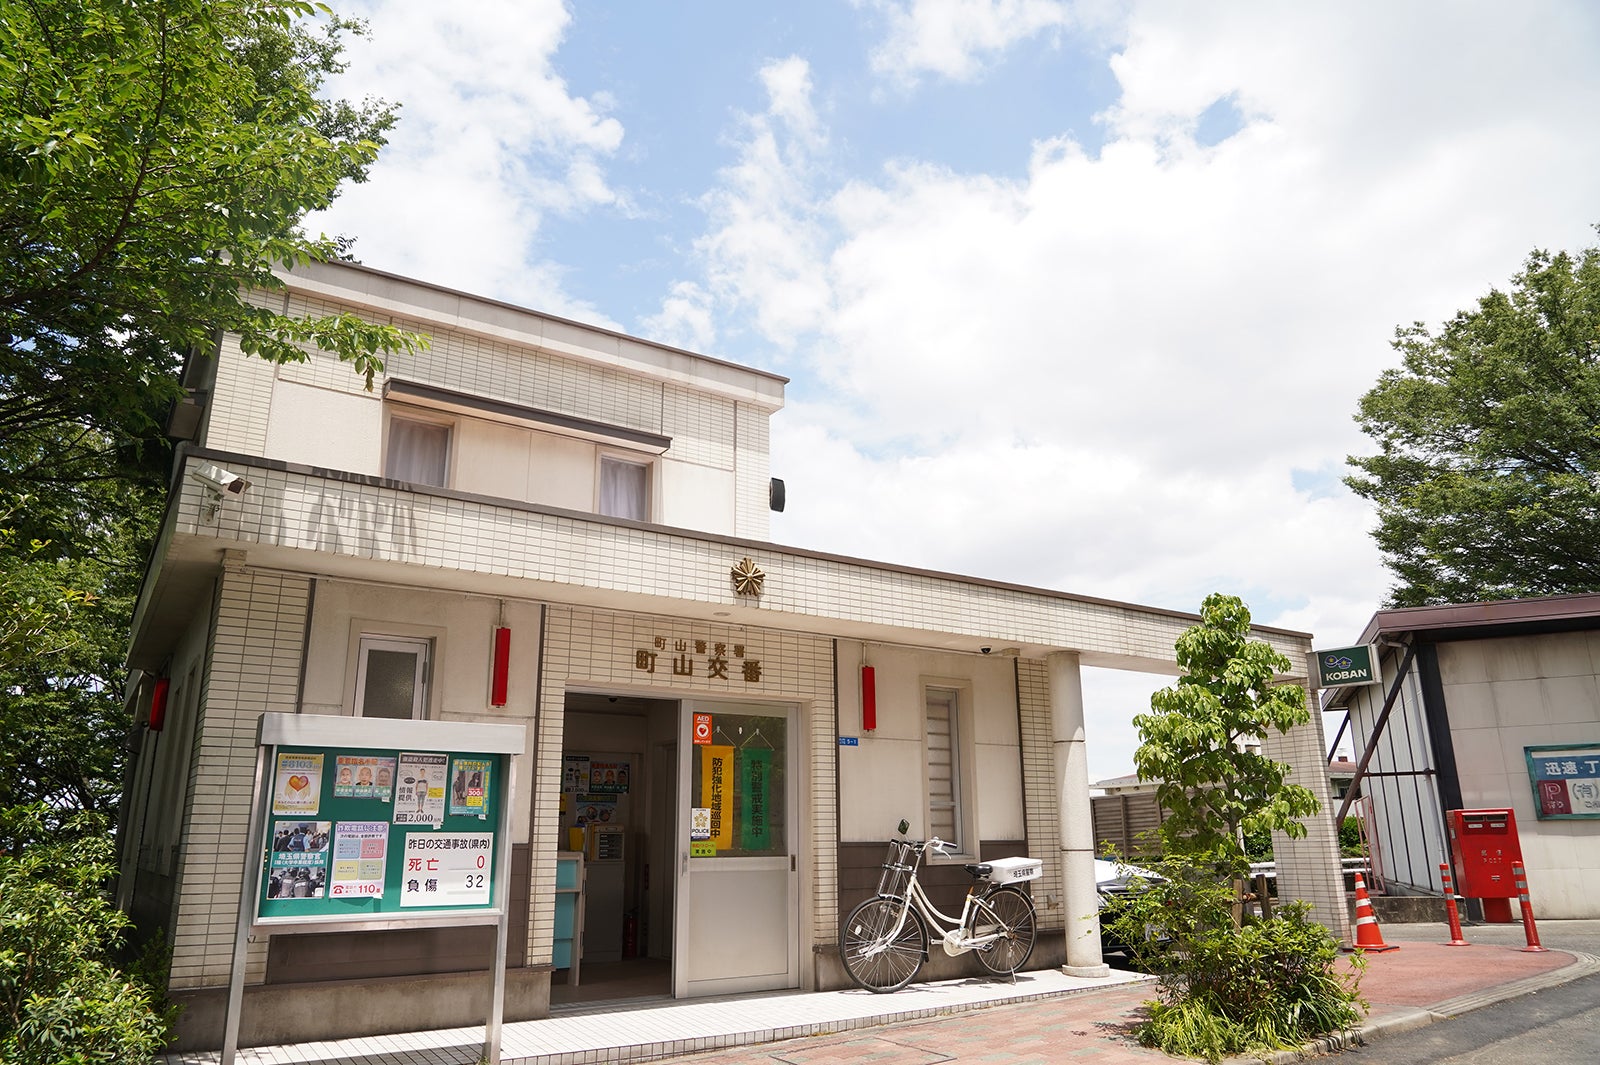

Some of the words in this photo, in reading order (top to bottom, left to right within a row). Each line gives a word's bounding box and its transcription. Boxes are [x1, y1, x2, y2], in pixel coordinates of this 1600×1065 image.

[654, 635, 745, 658] 町山警察署
[635, 650, 762, 683] 町山交番
[1326, 668, 1367, 681] KOBAN
[710, 757, 724, 838] 防犯強化地域巡回中
[750, 759, 763, 838] 特別警戒実施中
[408, 838, 490, 850] 昨日の交通事故(県内)
[408, 857, 439, 872] 死亡
[476, 855, 485, 869] 0
[407, 878, 438, 893] 負傷
[465, 874, 484, 889] 32
